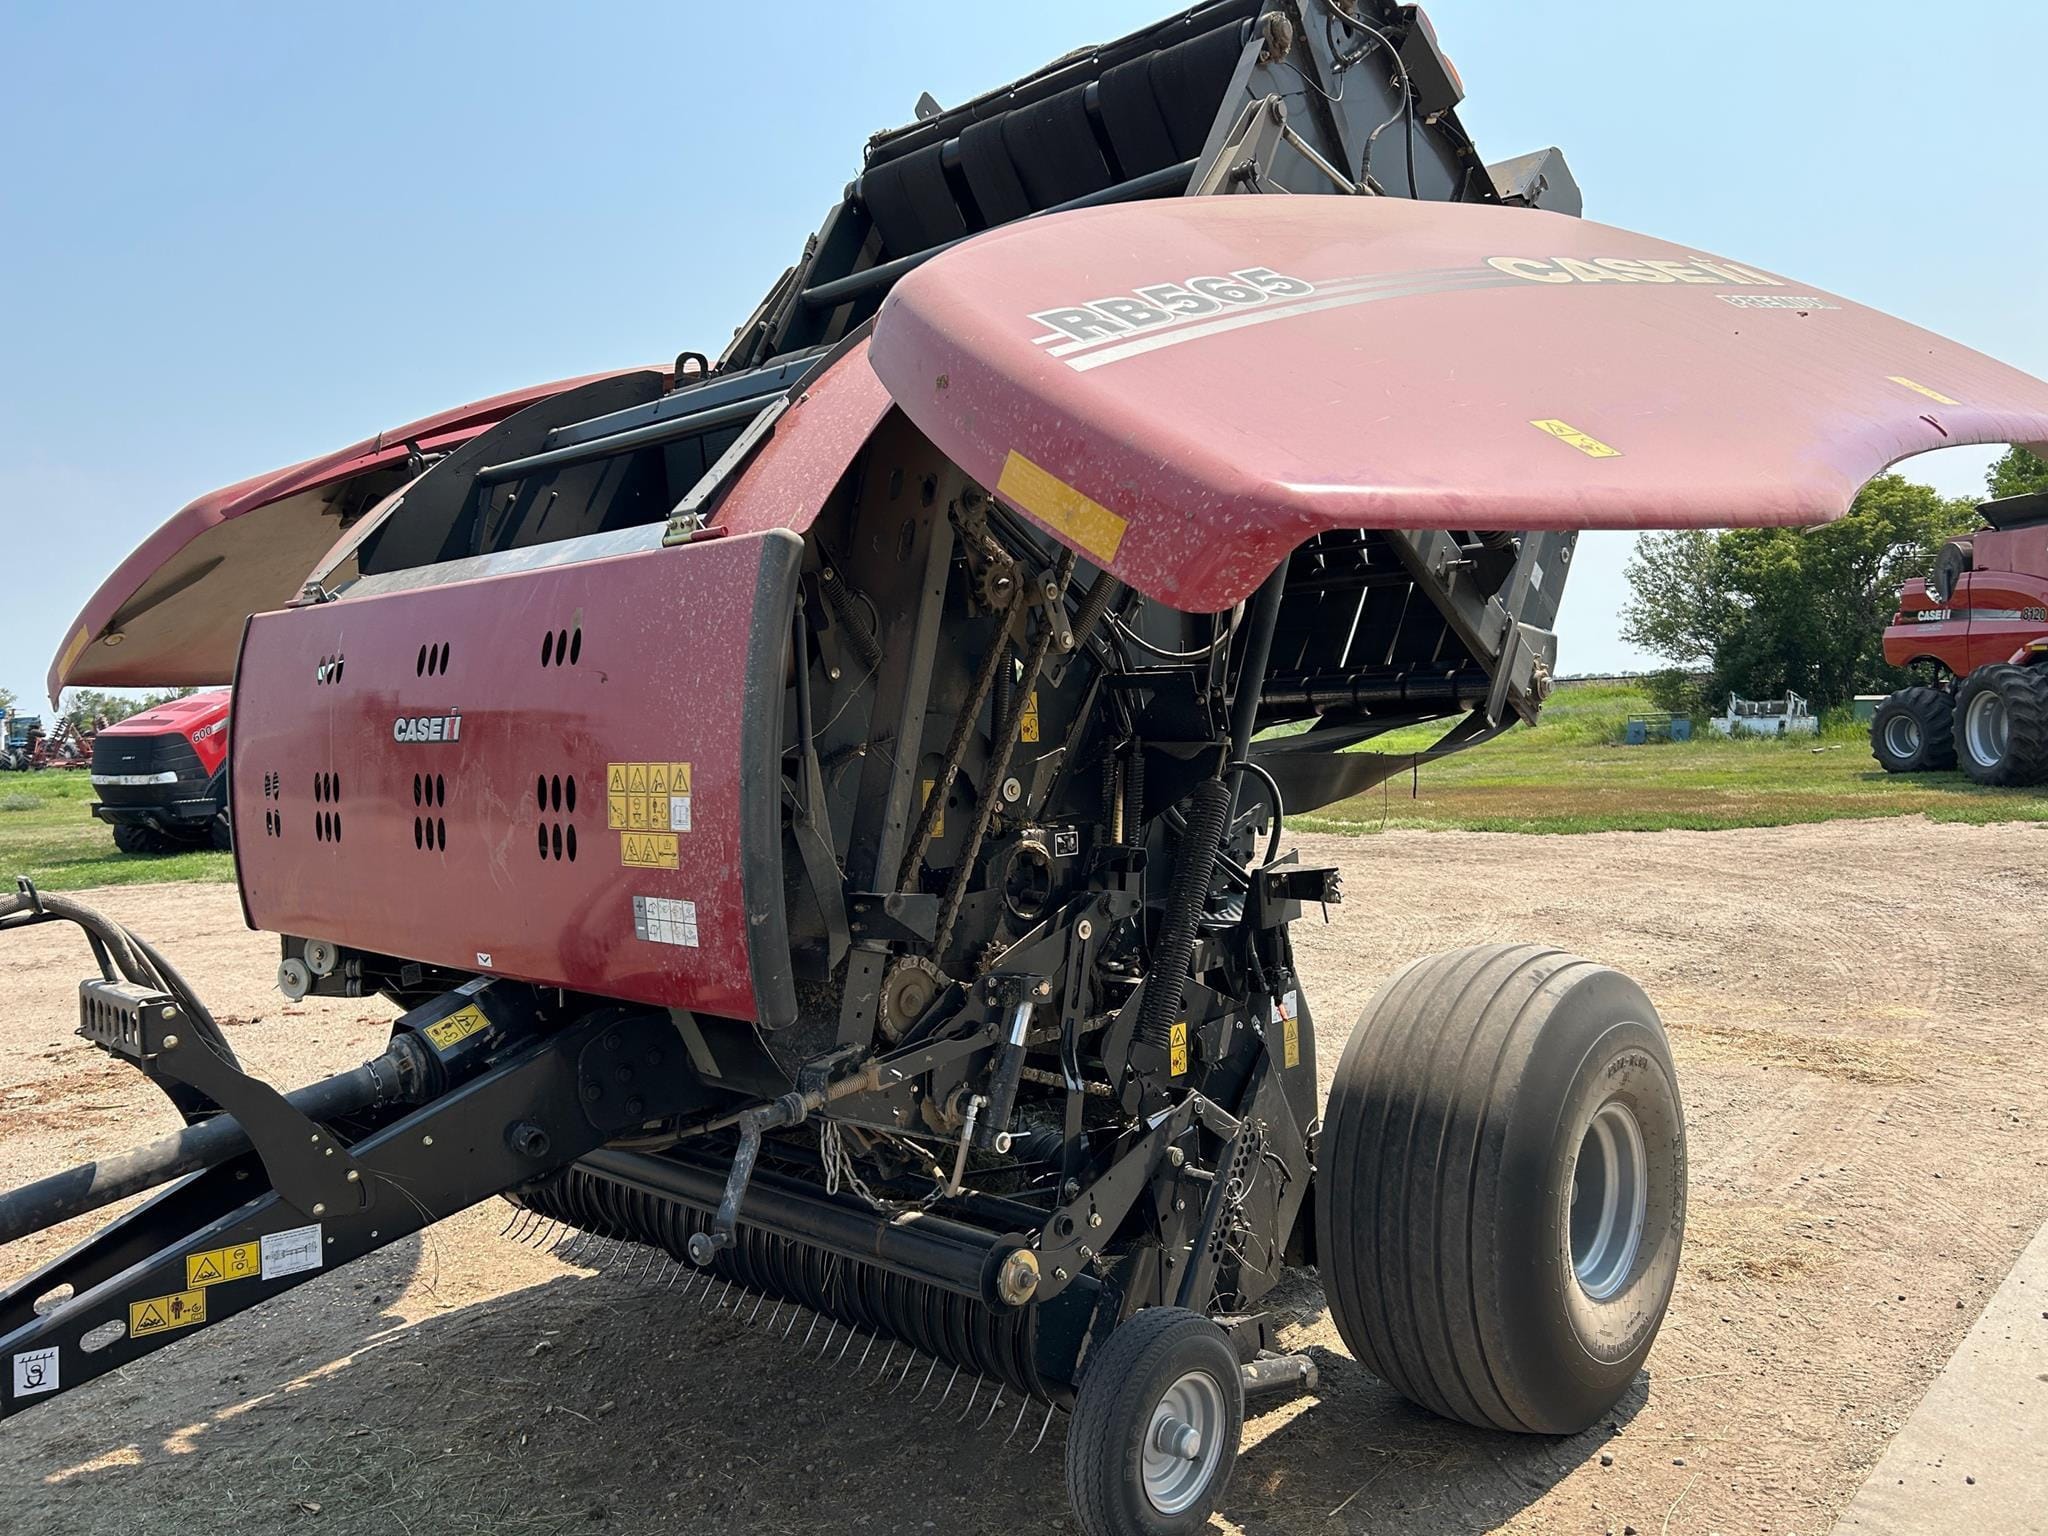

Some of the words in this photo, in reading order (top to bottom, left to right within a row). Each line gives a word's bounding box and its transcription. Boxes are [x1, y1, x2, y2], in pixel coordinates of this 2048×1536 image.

[1026, 266, 1315, 343] RB565
[2022, 607, 2046, 622] 8120
[192, 725, 212, 743] 600
